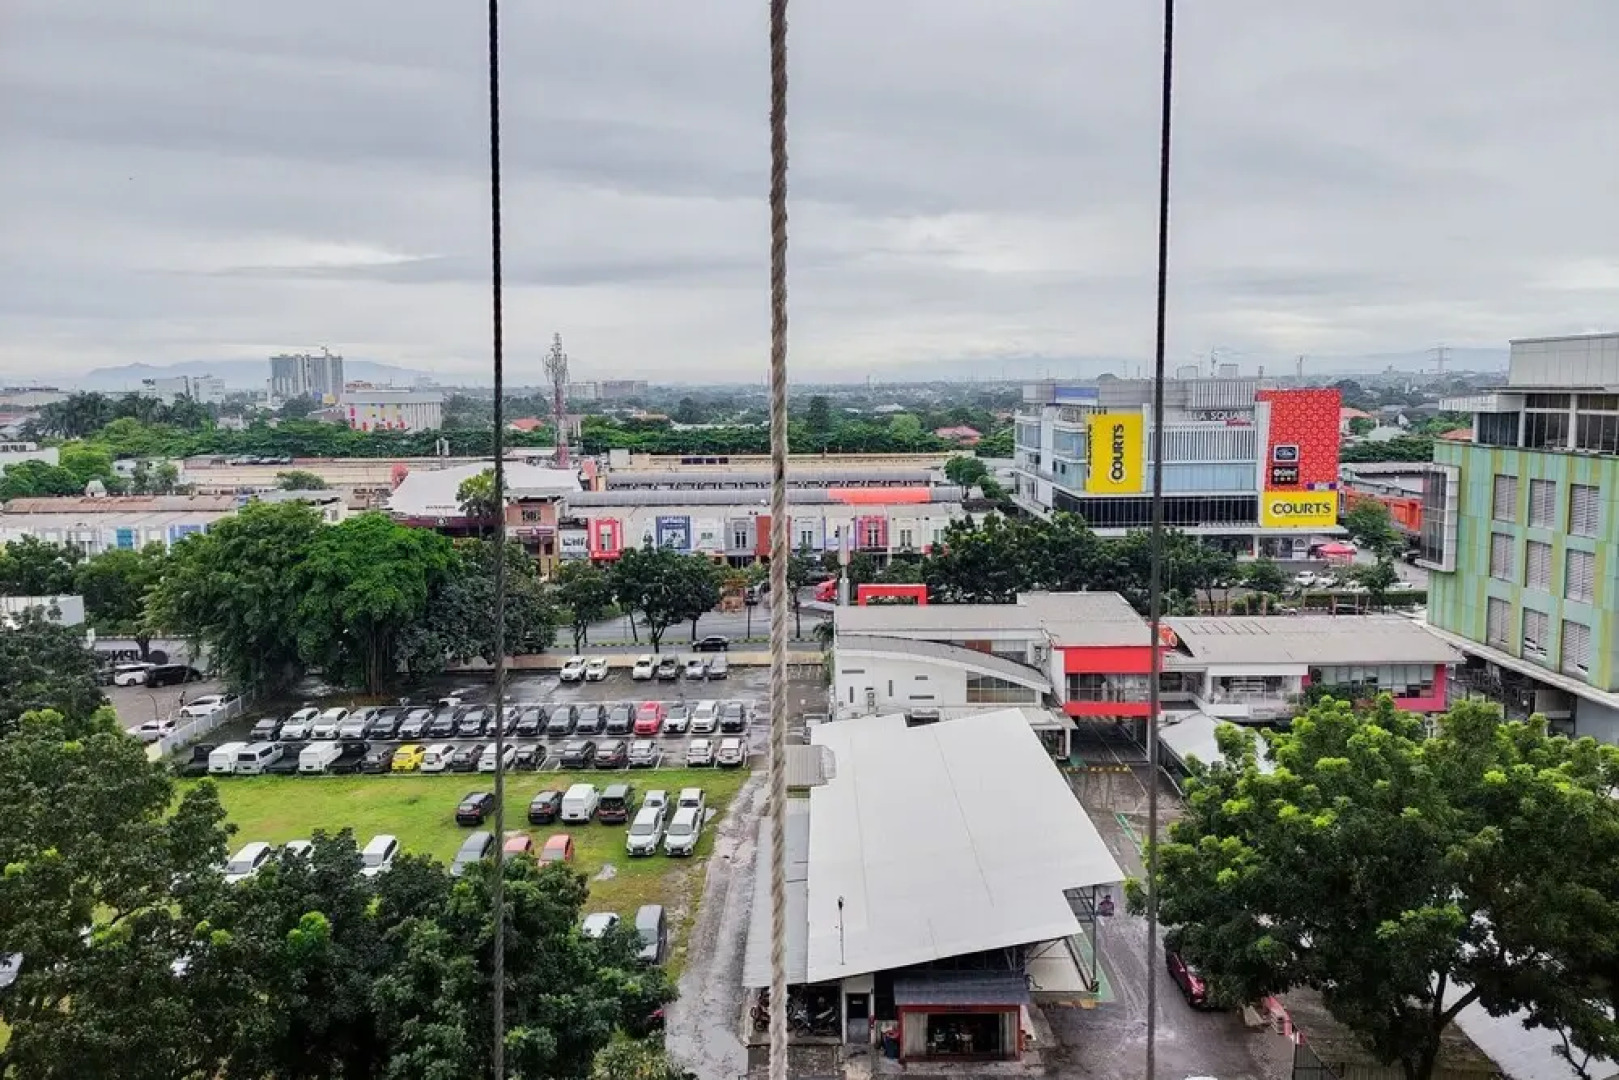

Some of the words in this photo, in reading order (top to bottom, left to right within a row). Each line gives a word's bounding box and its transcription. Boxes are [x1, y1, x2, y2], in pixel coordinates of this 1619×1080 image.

[1210, 410, 1251, 420] SQUARE
[1111, 423, 1124, 480] COURTS
[1272, 502, 1332, 514] COURTS
